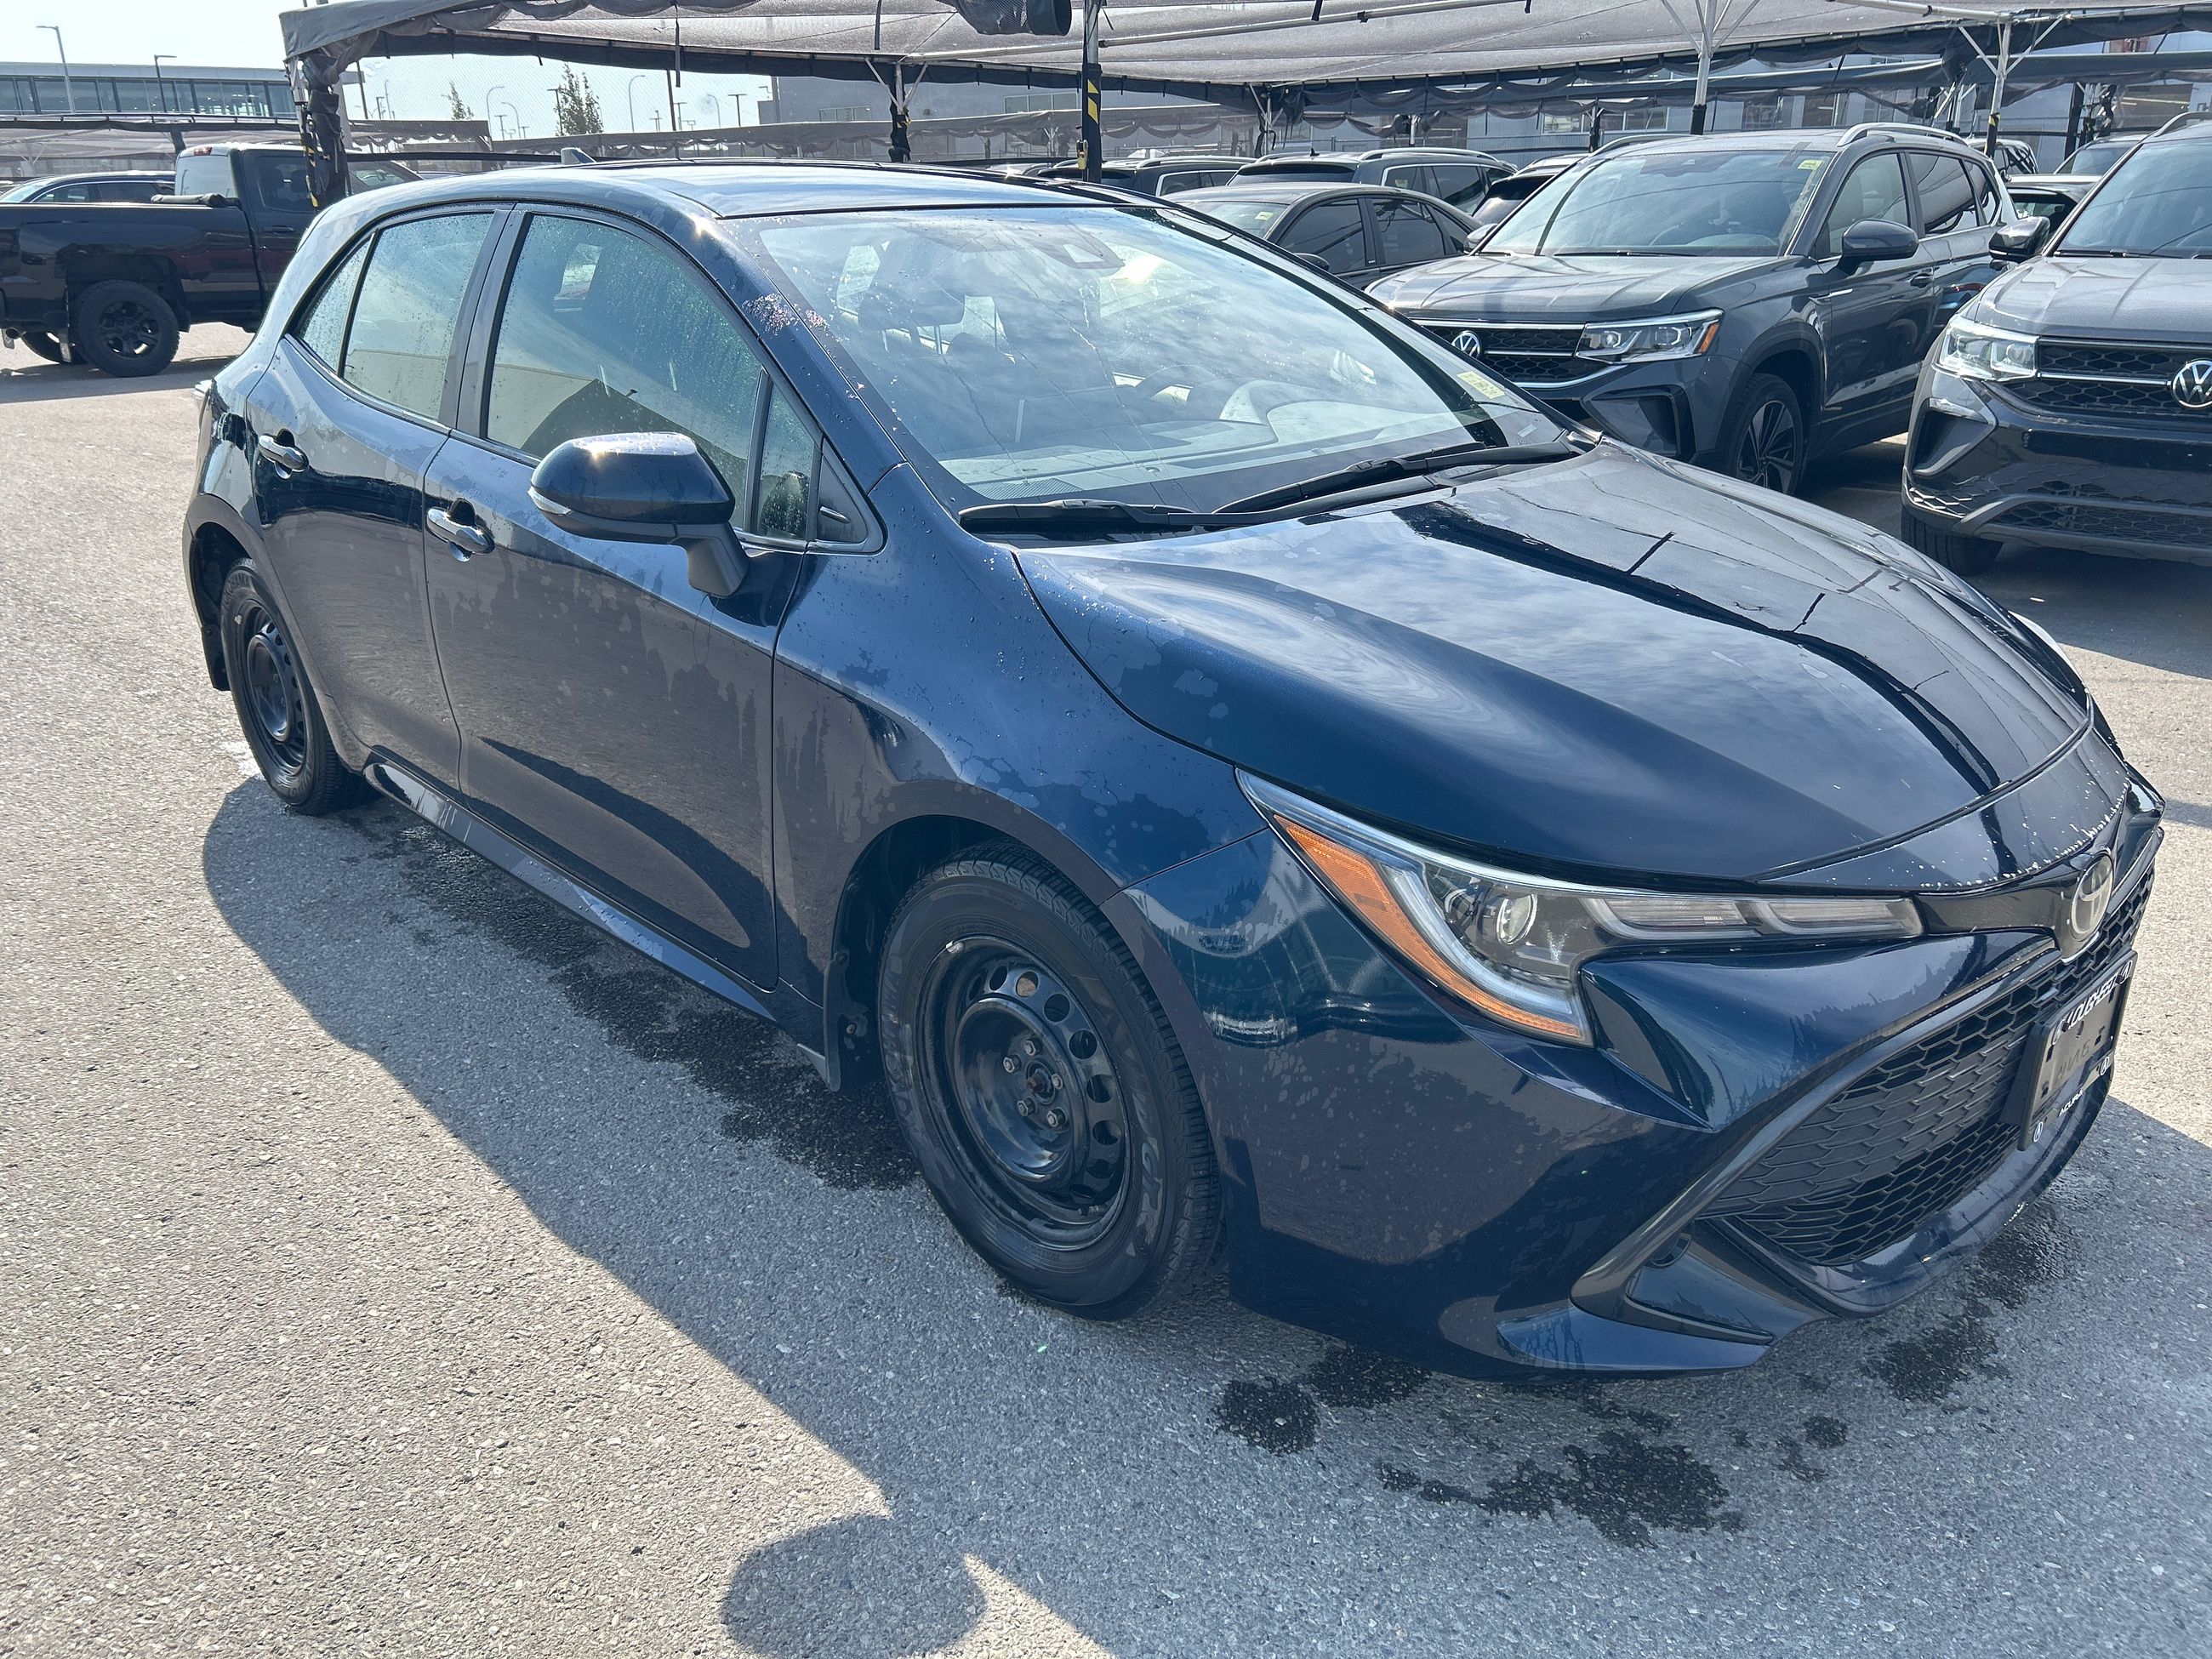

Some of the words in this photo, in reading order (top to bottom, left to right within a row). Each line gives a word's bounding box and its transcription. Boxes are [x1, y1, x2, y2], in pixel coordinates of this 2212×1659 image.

[2173, 360, 2212, 408] VW
[2066, 972, 2119, 1029] LOUGHEED
[2059, 1089, 2082, 1116] ACURA
